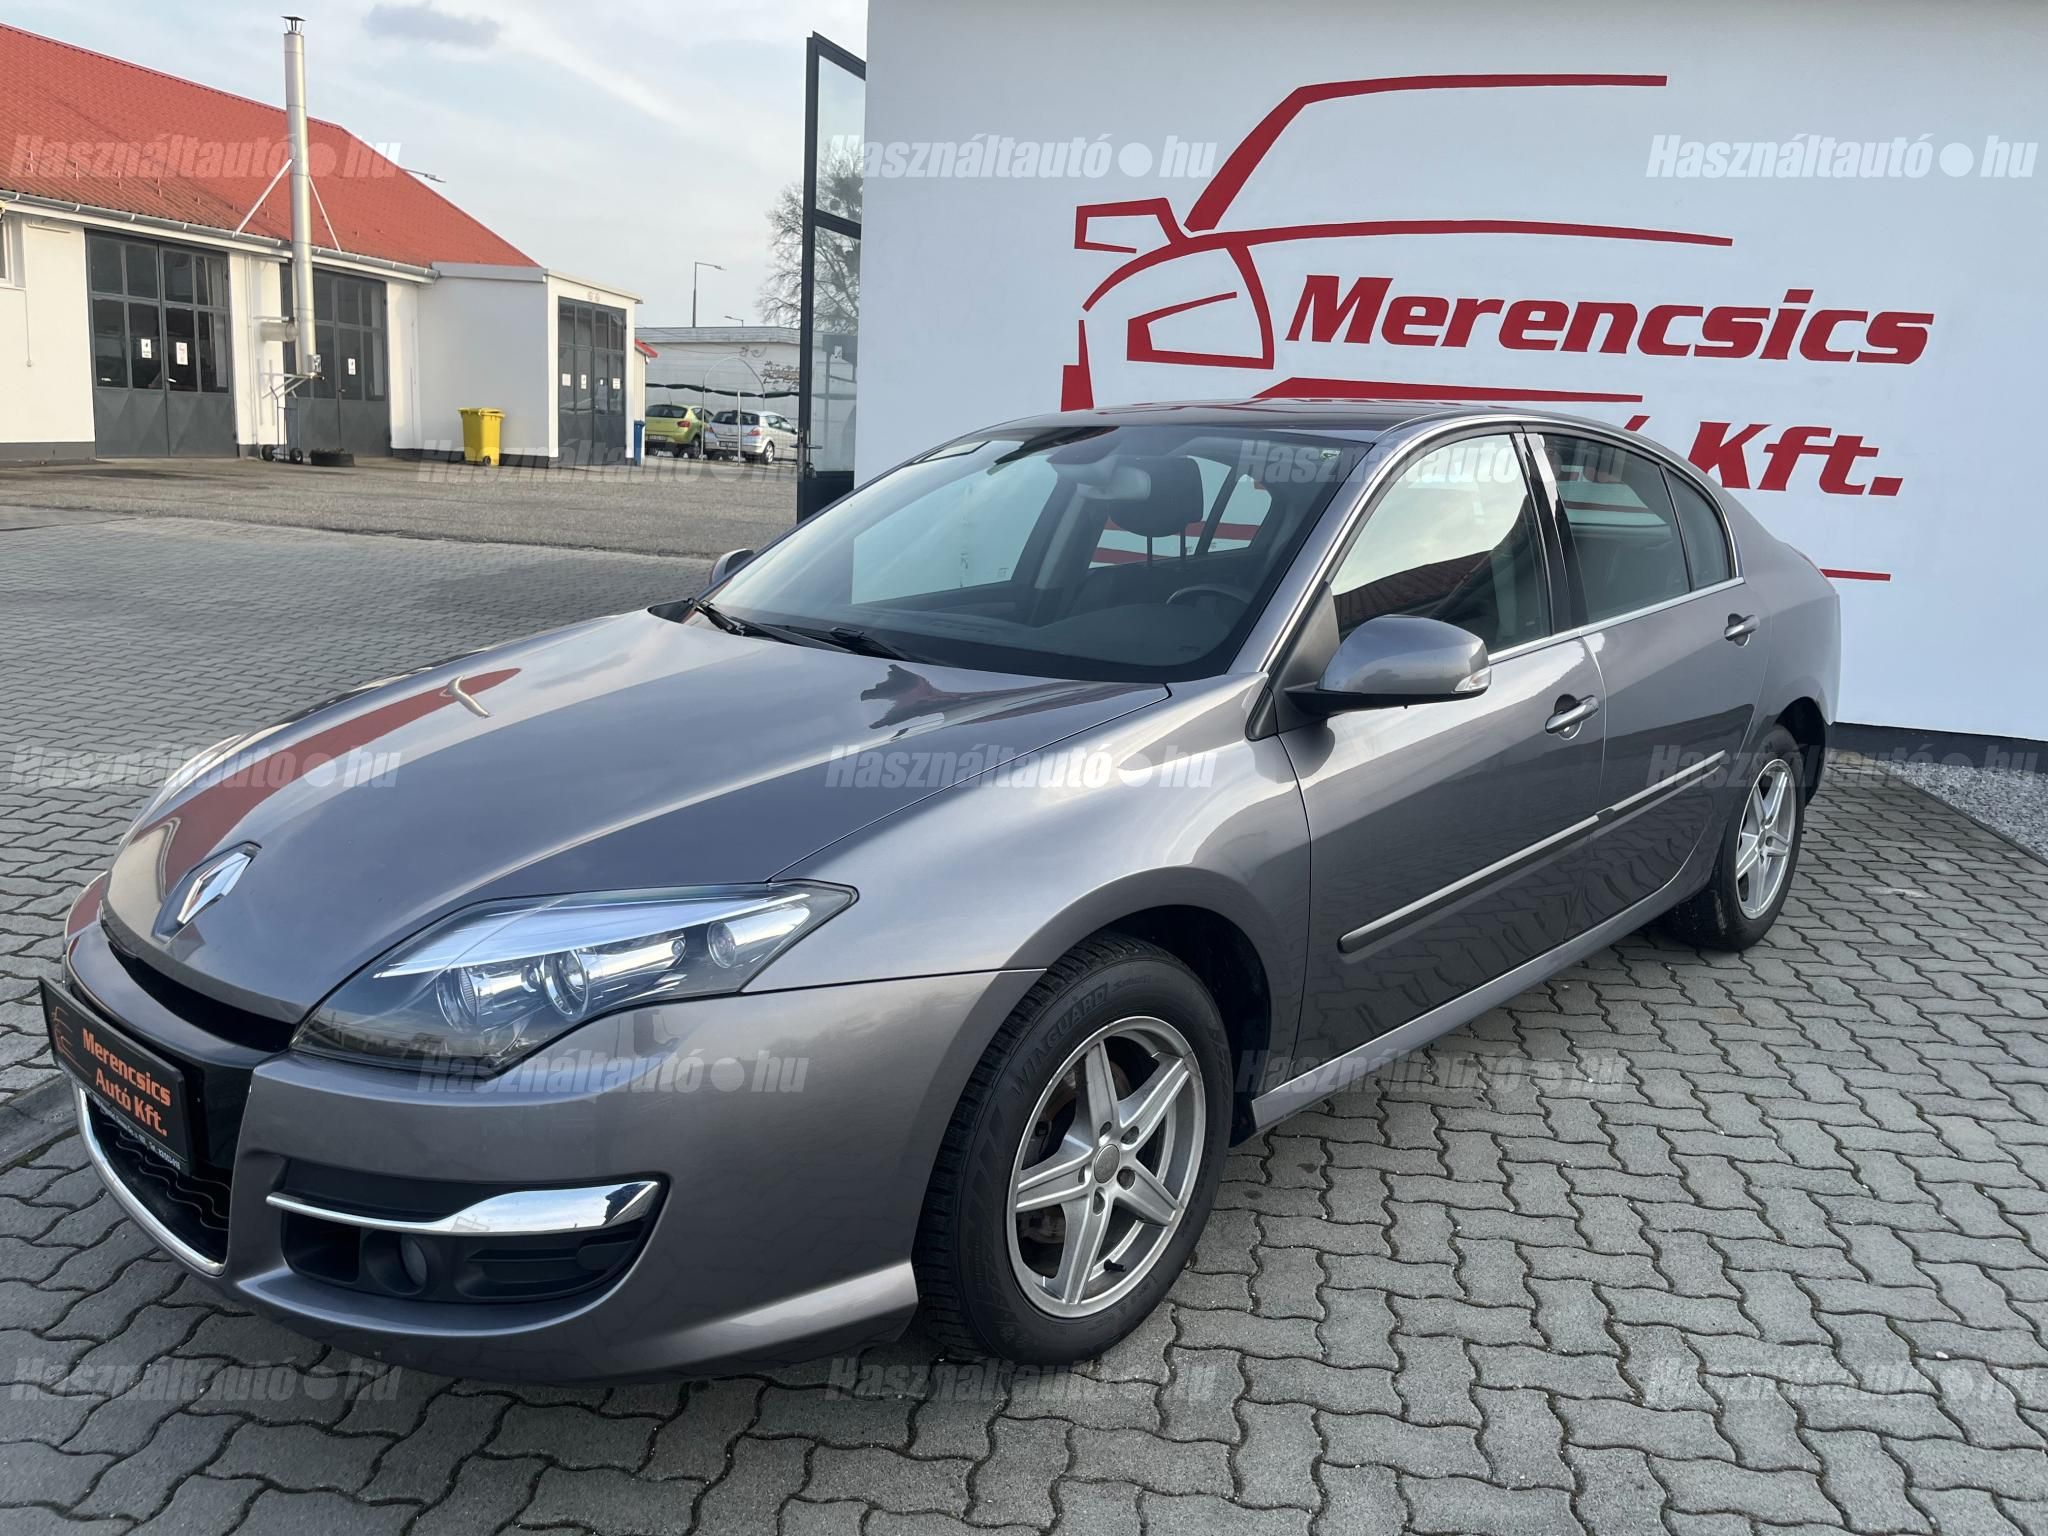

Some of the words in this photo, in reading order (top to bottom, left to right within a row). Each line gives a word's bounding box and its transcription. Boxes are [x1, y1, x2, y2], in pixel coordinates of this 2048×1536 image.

[1286, 275, 1935, 365] Merencsics
[1688, 421, 1904, 497] Kft.
[82, 1027, 172, 1107] Merencsics
[96, 1066, 132, 1112] Autó
[134, 1095, 168, 1137] Kft.
